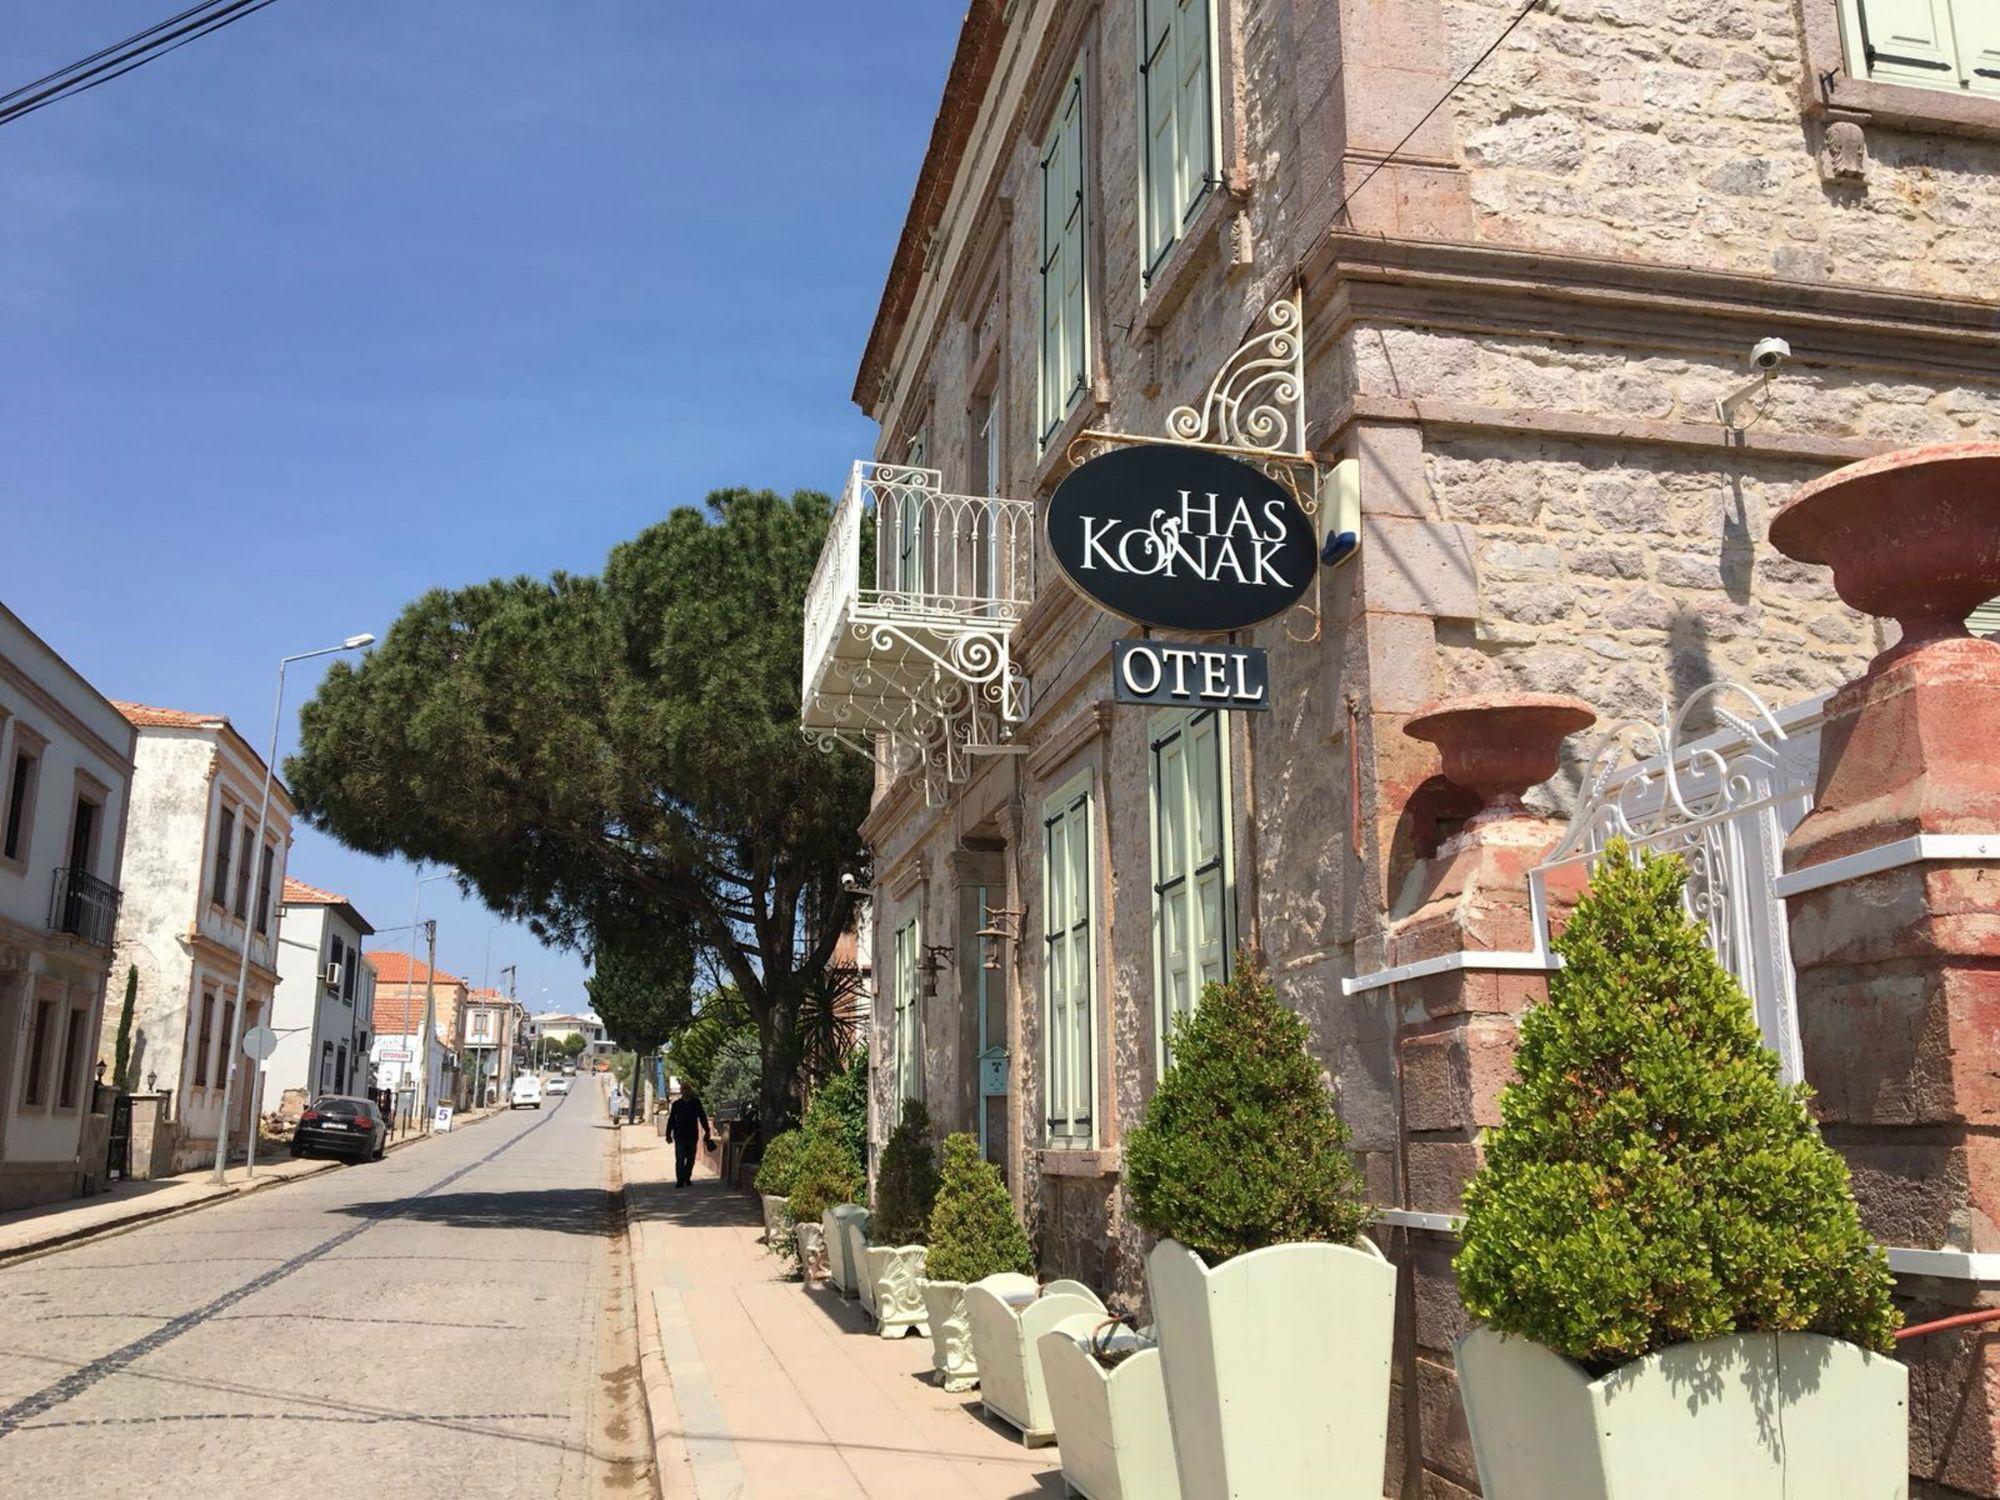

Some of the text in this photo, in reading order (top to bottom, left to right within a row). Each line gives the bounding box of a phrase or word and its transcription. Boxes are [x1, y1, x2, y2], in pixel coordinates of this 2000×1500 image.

[1177, 490, 1288, 543] HAS
[1079, 513, 1294, 588] KONAK
[1122, 646, 1264, 700] OTEL
[438, 1109, 448, 1121] 5
